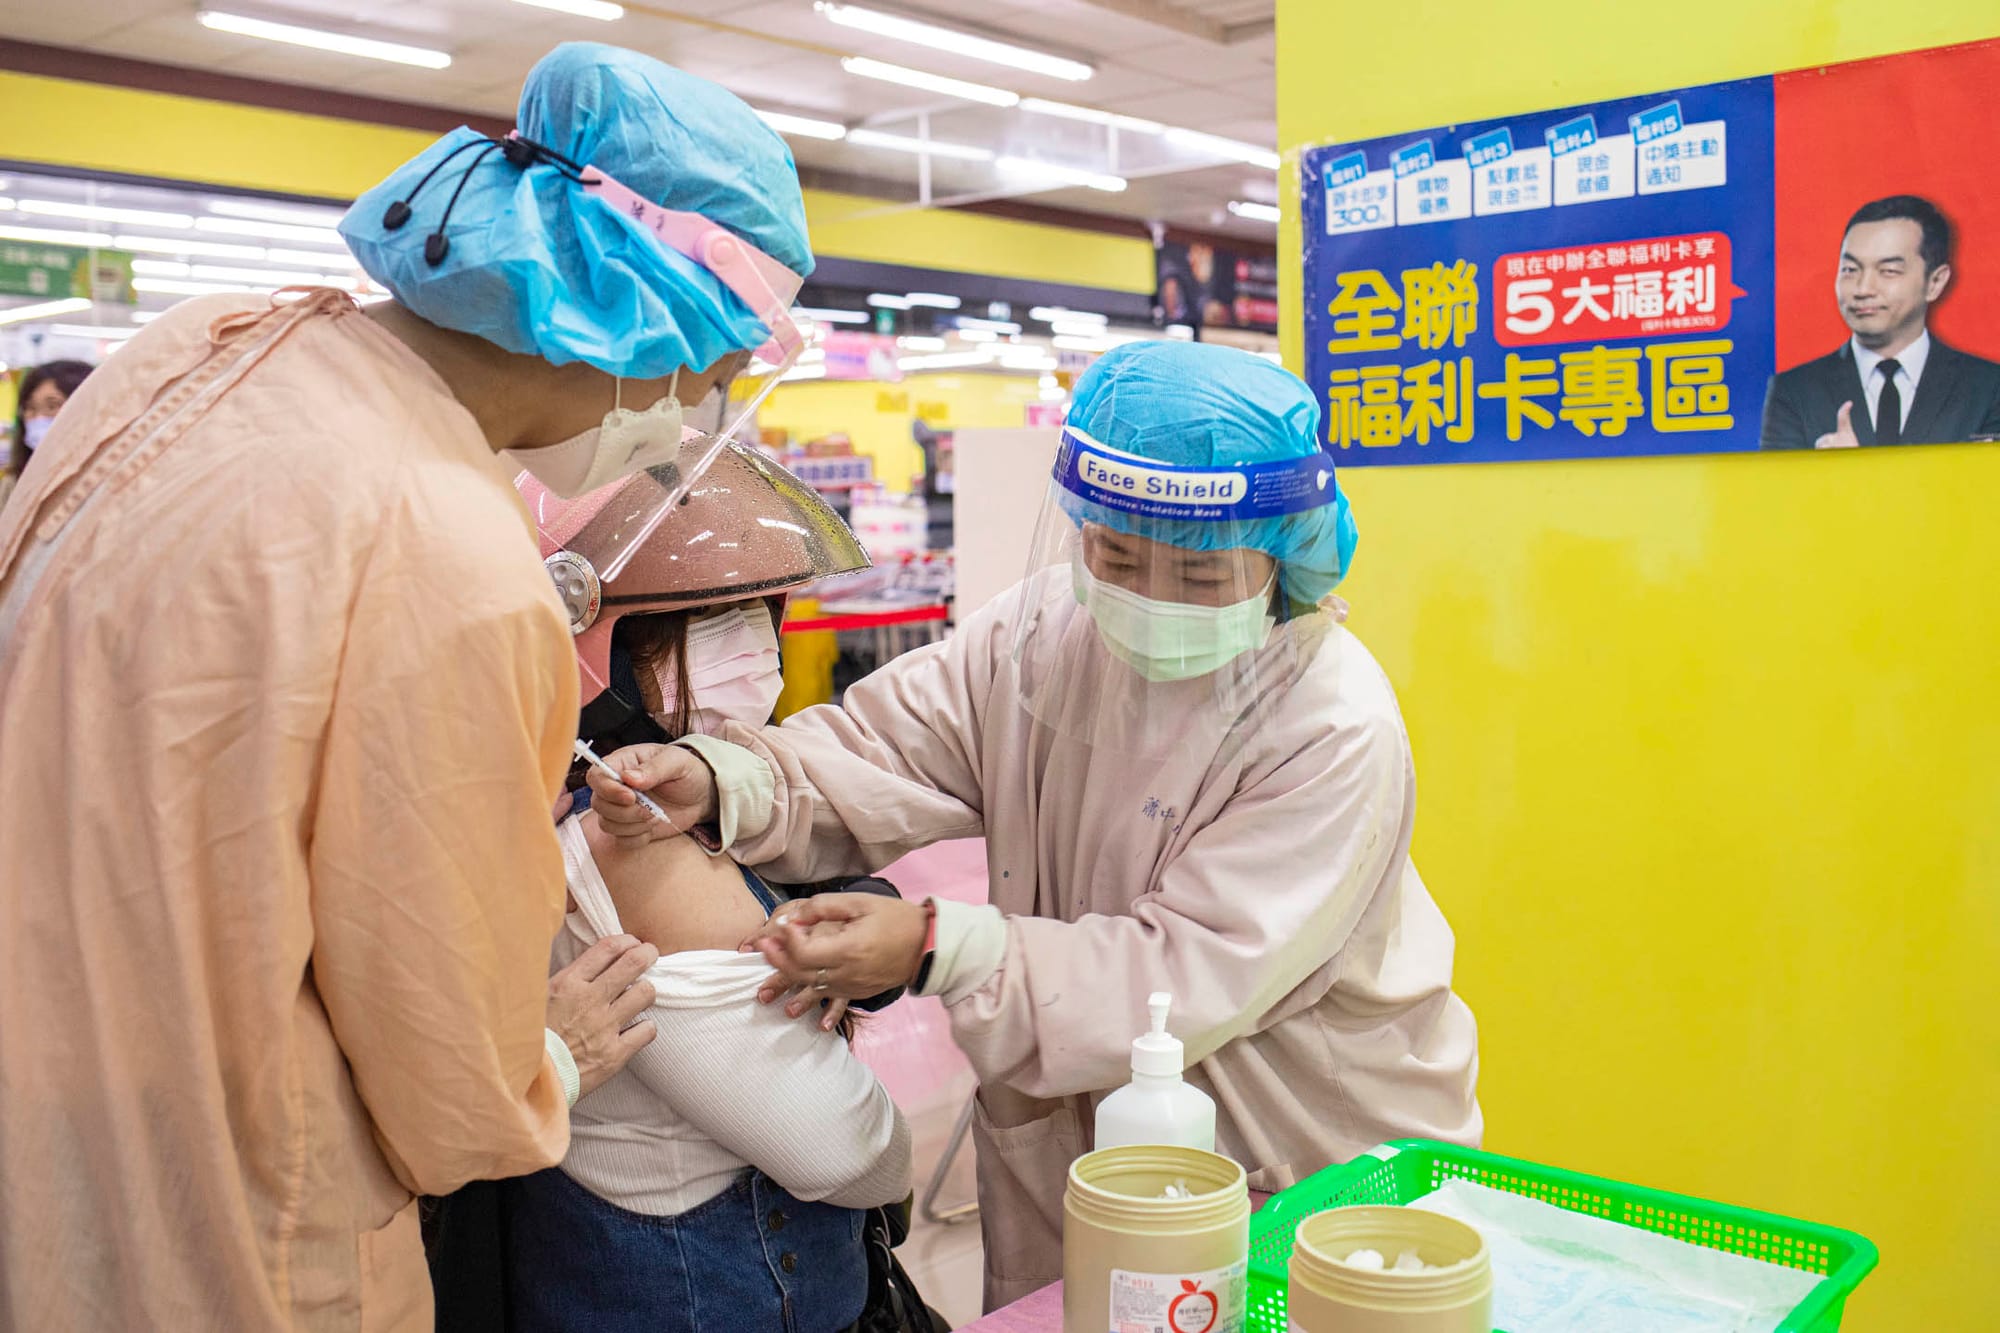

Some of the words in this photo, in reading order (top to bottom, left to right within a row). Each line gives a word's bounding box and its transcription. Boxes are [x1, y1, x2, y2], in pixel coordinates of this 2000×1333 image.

[1578, 154, 1609, 173] 現金
[1646, 166, 1681, 185] 通知
[1418, 177, 1448, 194] 購物
[1578, 175, 1609, 194] 儲值
[1419, 197, 1449, 214] 優惠
[1506, 238, 1716, 278] 現在申辦全聯福利卡享
[1328, 259, 1479, 354] 全聯
[1506, 264, 1716, 335] 5大福利
[1328, 339, 1735, 449] 福利卡專區
[1087, 460, 1135, 490] Face
[1146, 476, 1233, 498] Shield
[1089, 489, 1138, 510] Protective
[1140, 503, 1191, 517] Isolation
[1193, 507, 1222, 517] Mask
